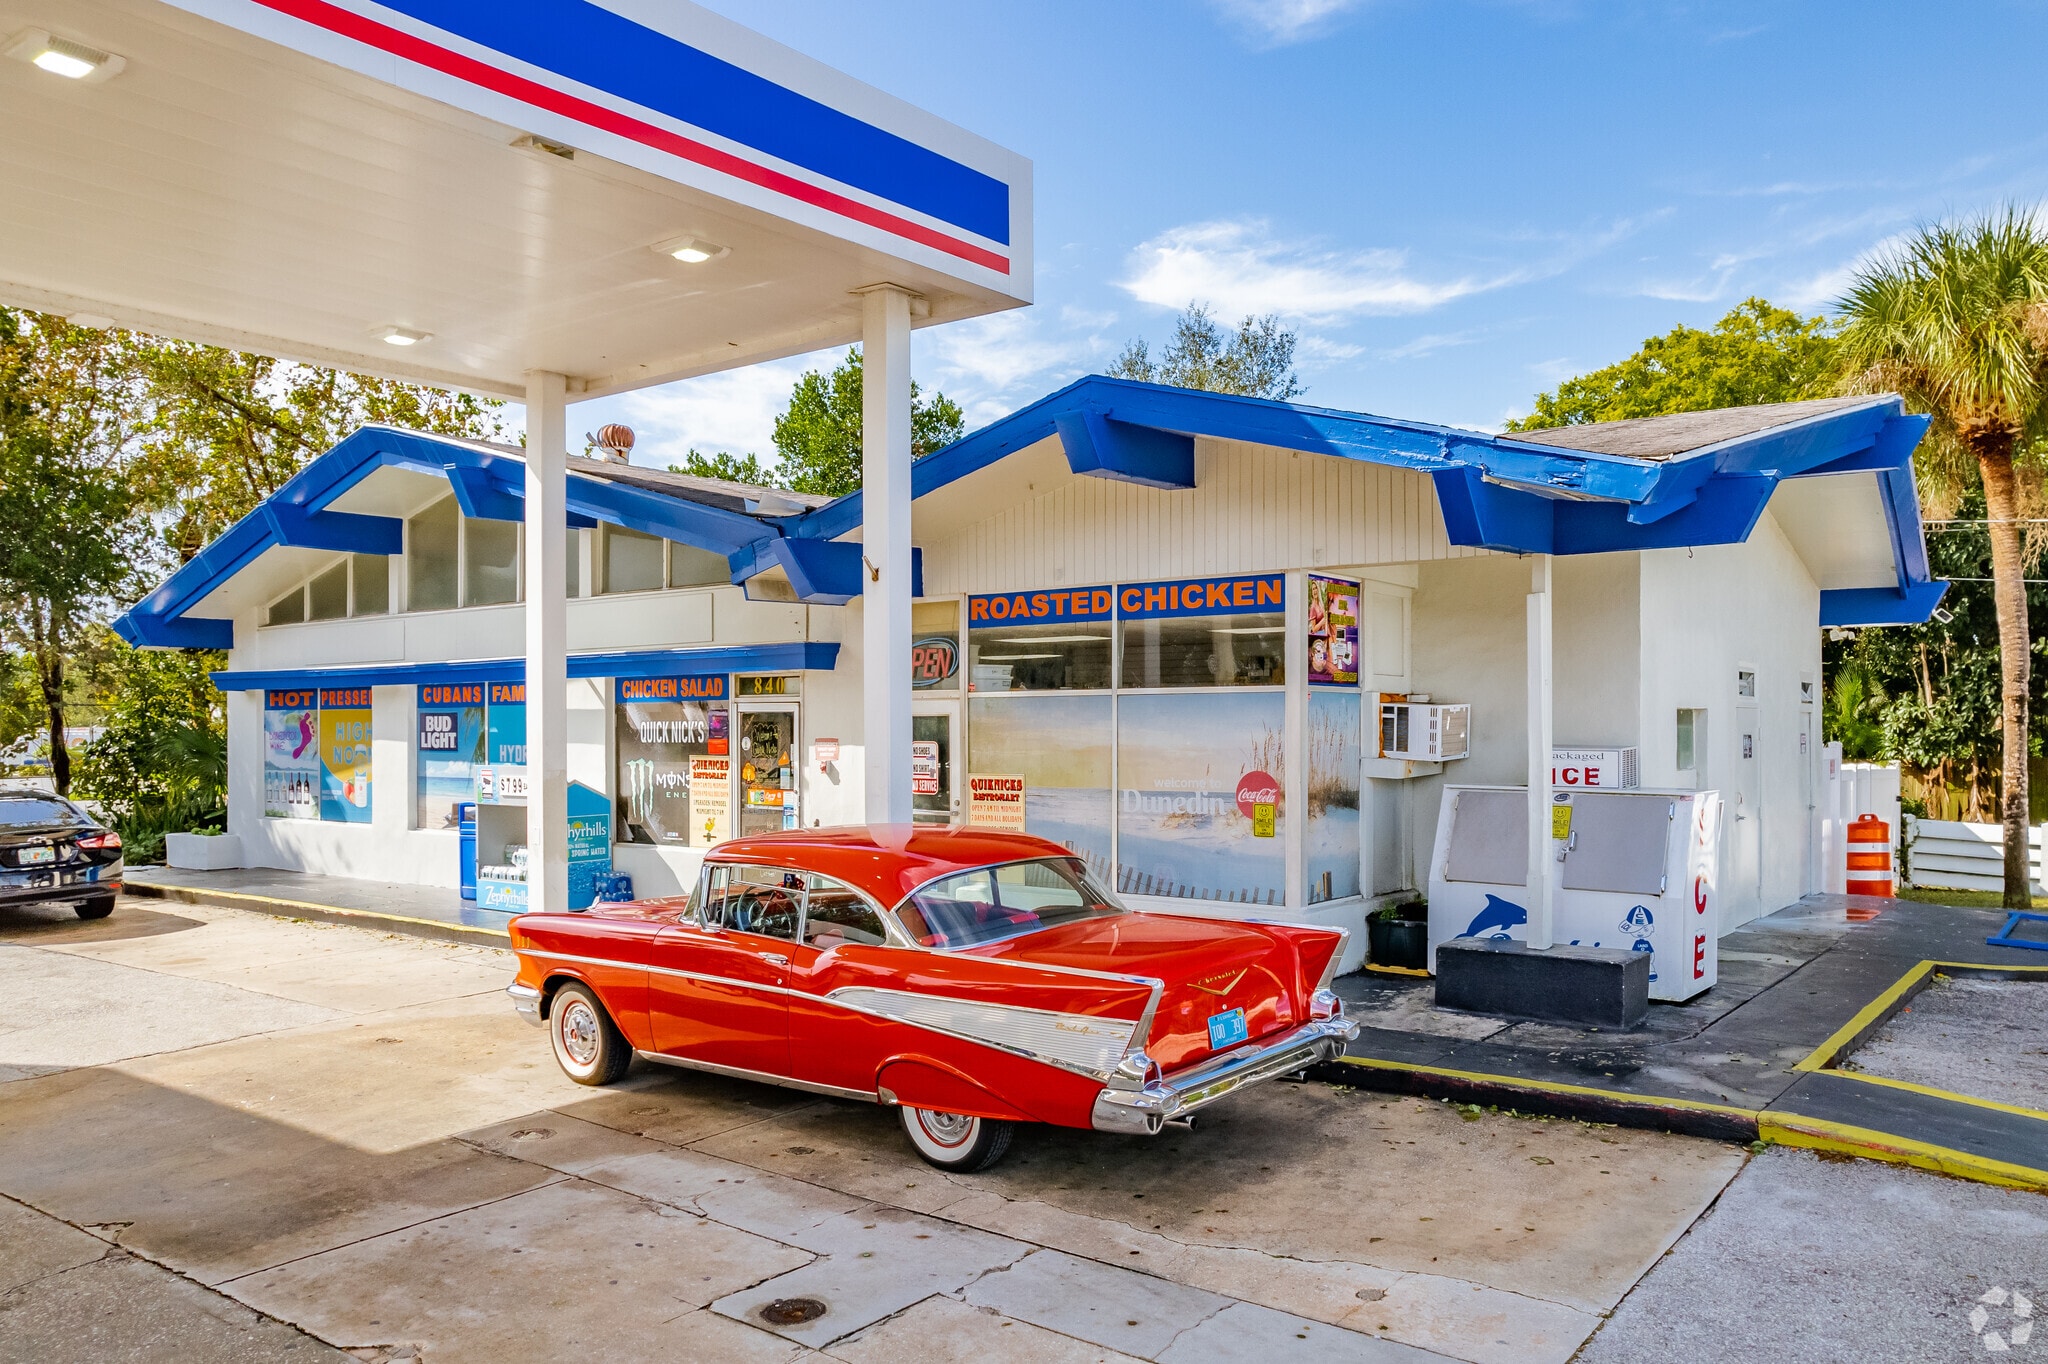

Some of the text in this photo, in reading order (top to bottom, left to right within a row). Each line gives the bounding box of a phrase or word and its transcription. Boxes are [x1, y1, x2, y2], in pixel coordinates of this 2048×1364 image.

[970, 579, 1282, 621] ROASTED CHICKEN
[912, 648, 952, 678] PEN
[492, 684, 527, 703] FAM
[622, 677, 723, 699] CHICKEN SALAD
[754, 676, 785, 694] 840
[269, 691, 315, 707] HOT
[423, 686, 482, 704] CUBANS
[335, 721, 373, 742] HIGH
[425, 715, 453, 732] BUD
[640, 720, 670, 744] QUICK
[671, 720, 705, 744] NICK'S
[420, 731, 457, 749] LIGHT
[1552, 752, 1604, 761] ackaged
[655, 771, 690, 790] MONS
[919, 779, 937, 792] SERVICE
[1154, 777, 1223, 789] welcome to
[1552, 767, 1600, 786] ICE
[665, 791, 688, 799] ENE
[1122, 789, 1227, 816] Dunedin
[1237, 787, 1278, 804] Coca-Cola
[567, 821, 607, 841] hyrhills
[1197, 969, 1236, 985] Chevrolet
